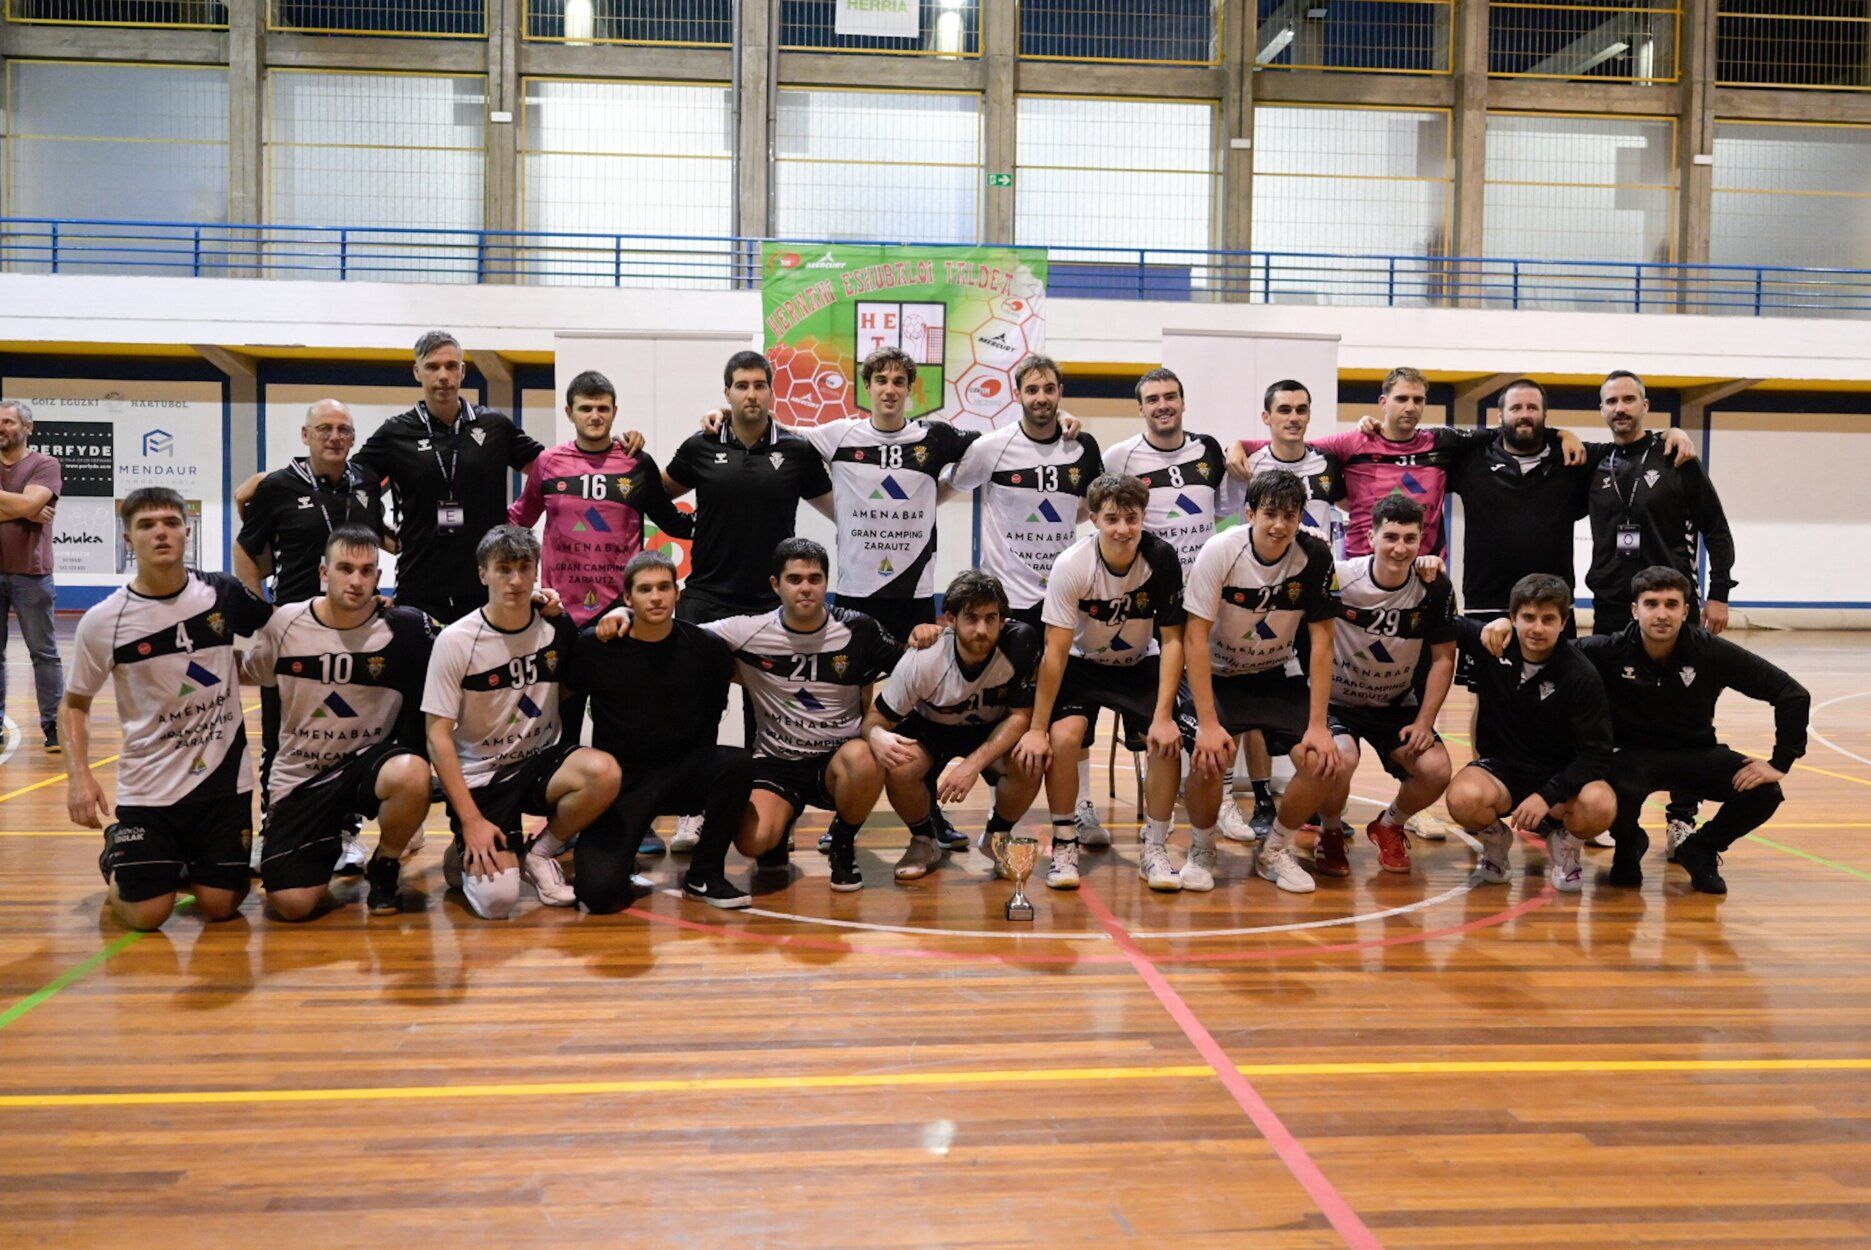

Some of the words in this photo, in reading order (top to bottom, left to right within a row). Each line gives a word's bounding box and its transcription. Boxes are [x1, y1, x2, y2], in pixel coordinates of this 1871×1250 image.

[847, 0, 908, 12] HERRIA
[766, 278, 837, 340] HERNANI
[842, 259, 935, 297] ESKUBALOI
[944, 260, 1015, 297] TALDEA
[861, 313, 875, 329] H
[883, 313, 897, 329] E
[871, 336, 884, 350] T
[978, 336, 1016, 352] MERCURY
[28, 445, 112, 456] PERFYDE
[877, 444, 904, 469] 18
[119, 465, 197, 475] MENDAUR
[1167, 465, 1185, 489] 8
[1034, 465, 1059, 492] 13
[580, 474, 608, 500] 16
[446, 510, 456, 522] E
[852, 509, 925, 519] AMENABAR
[851, 529, 877, 538] GRAN
[880, 530, 923, 539] CAMPING
[556, 543, 630, 553] AMENABAR
[864, 541, 910, 551] ZARAUTZ
[556, 563, 580, 571] GRAN
[583, 563, 625, 572] CAMPIN
[568, 575, 614, 585] ZARAUTZ
[1365, 608, 1401, 637] 29
[175, 621, 195, 653] 4
[318, 652, 354, 685] 10
[509, 654, 538, 690] 95
[788, 653, 818, 682] 21
[1332, 658, 1411, 679] AMENABAR
[158, 687, 232, 724] AMENABR
[291, 727, 383, 740] AMENABAR
